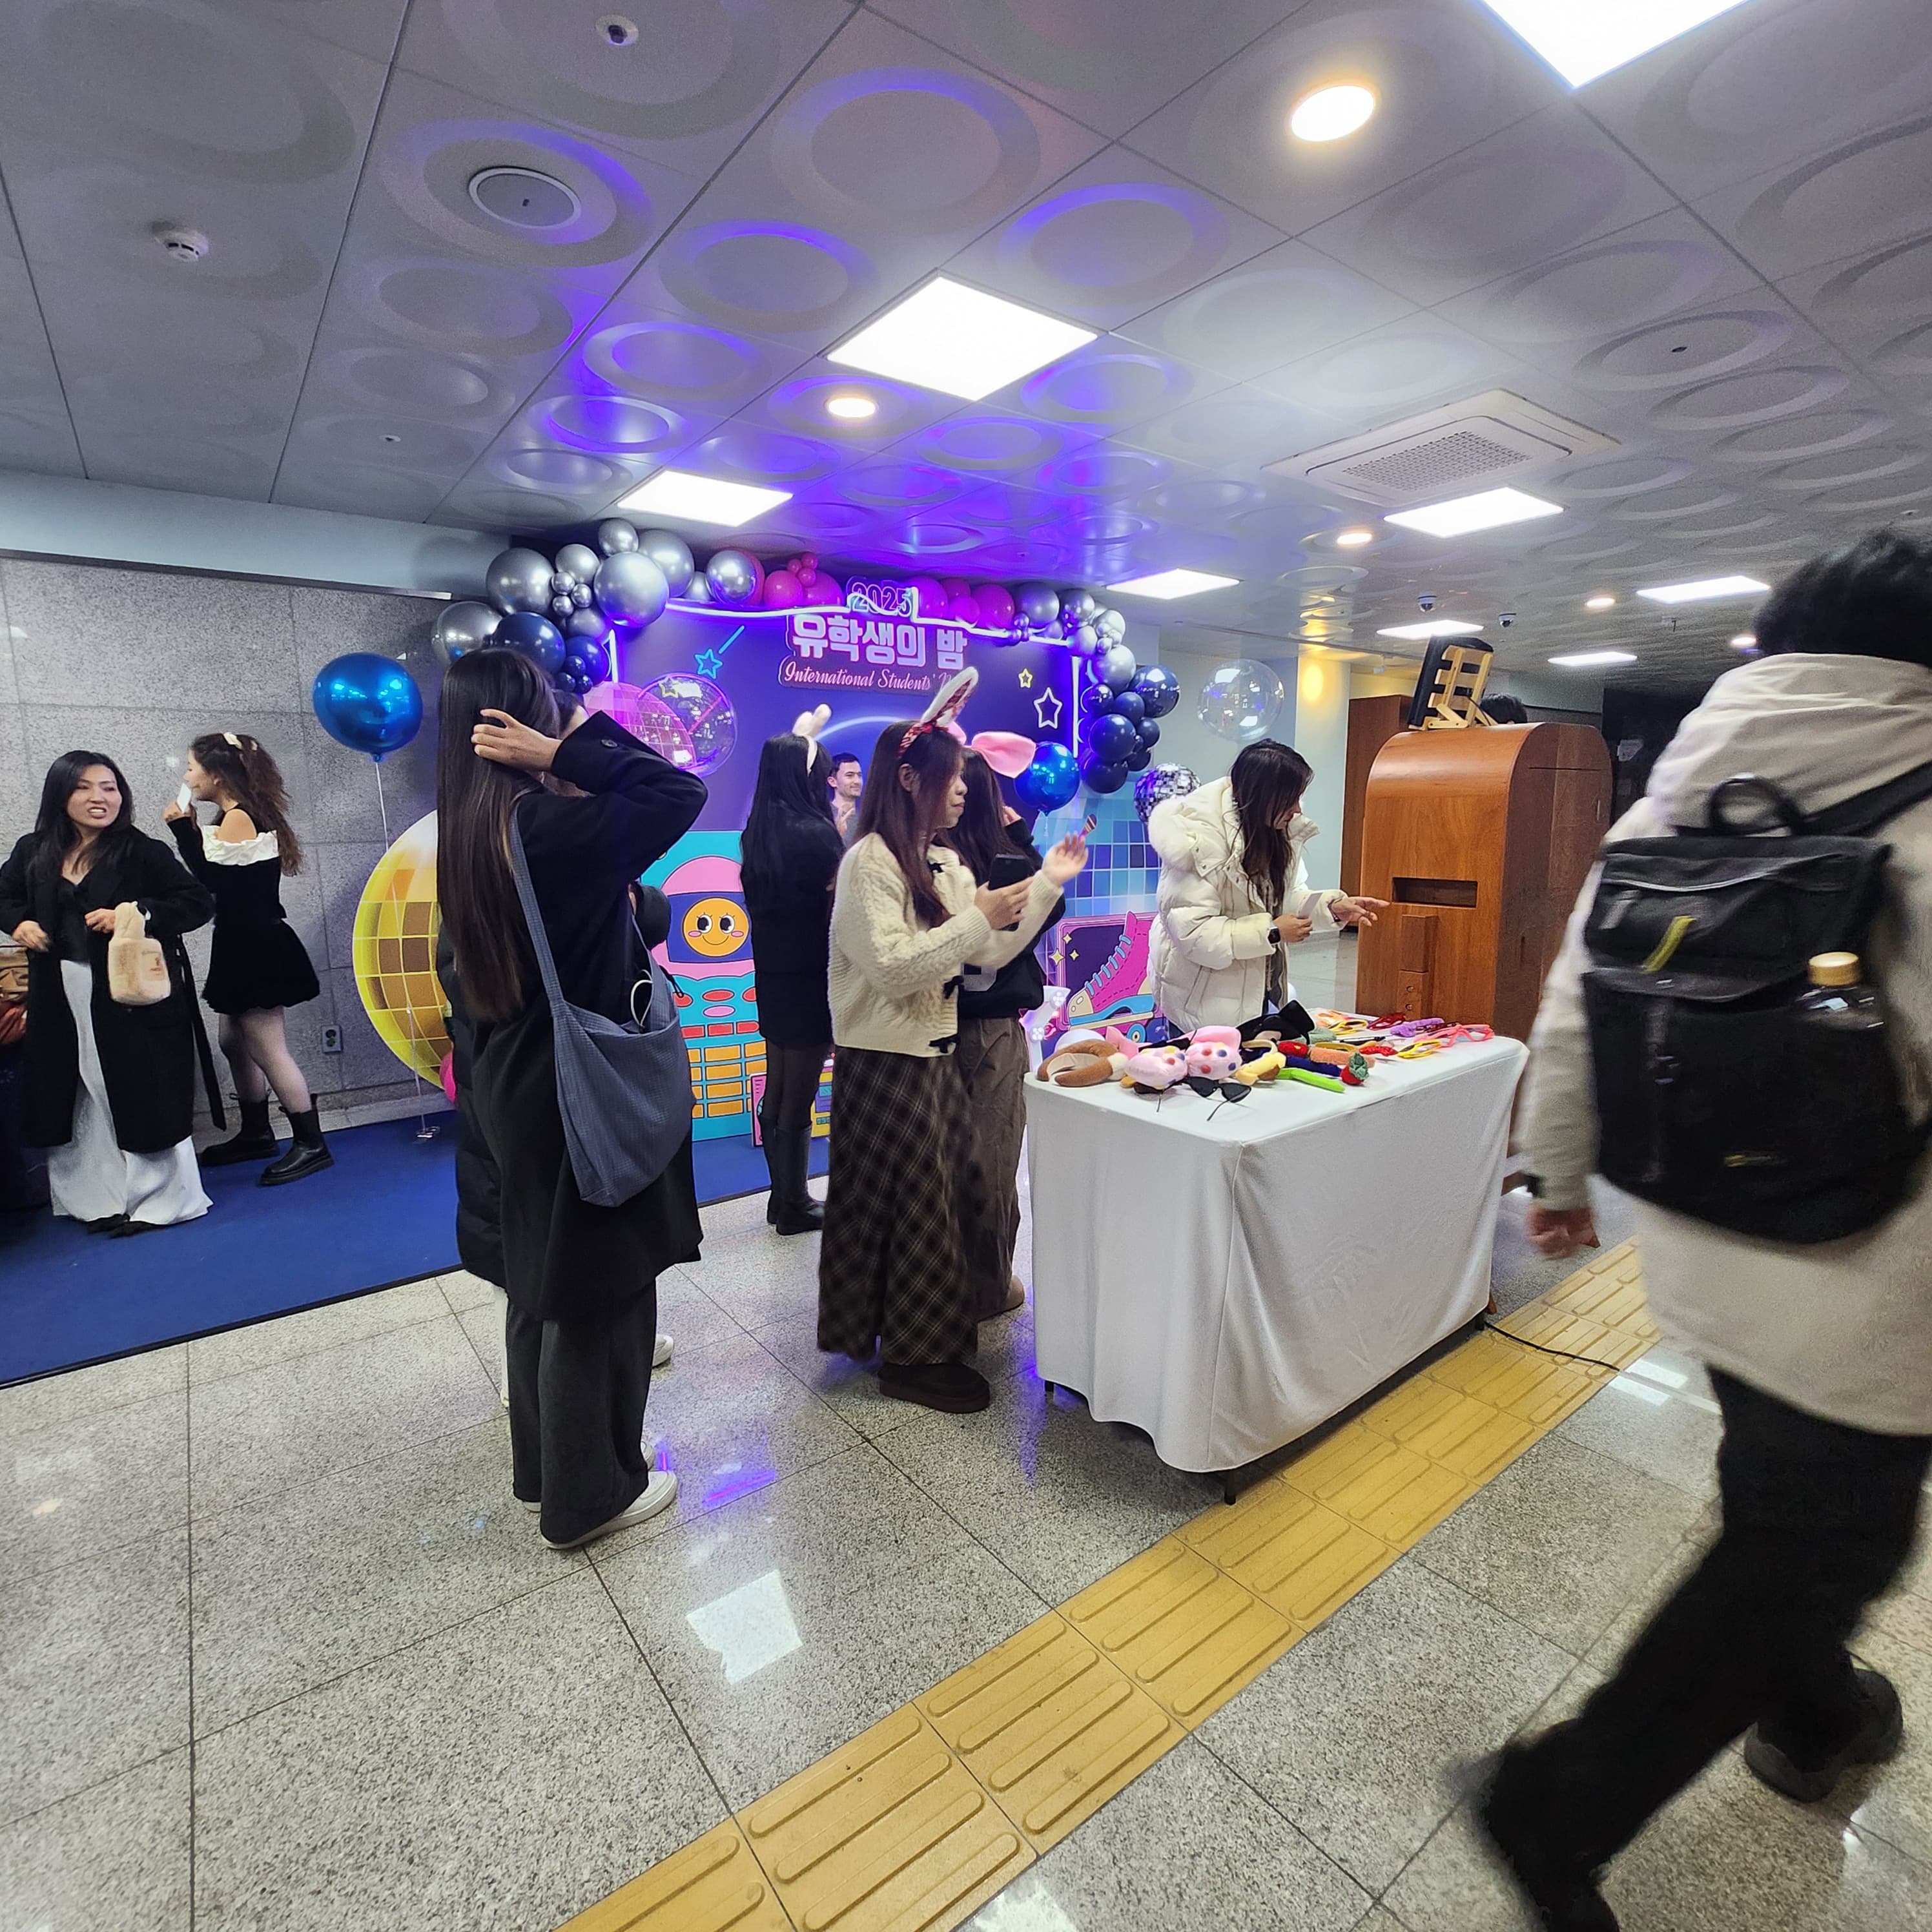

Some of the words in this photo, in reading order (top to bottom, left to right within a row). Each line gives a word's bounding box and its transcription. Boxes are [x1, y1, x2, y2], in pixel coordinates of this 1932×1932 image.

[852, 582, 912, 617] 2025
[792, 613, 926, 668] 유학생의
[936, 628, 968, 670] 밤
[784, 661, 875, 687] International
